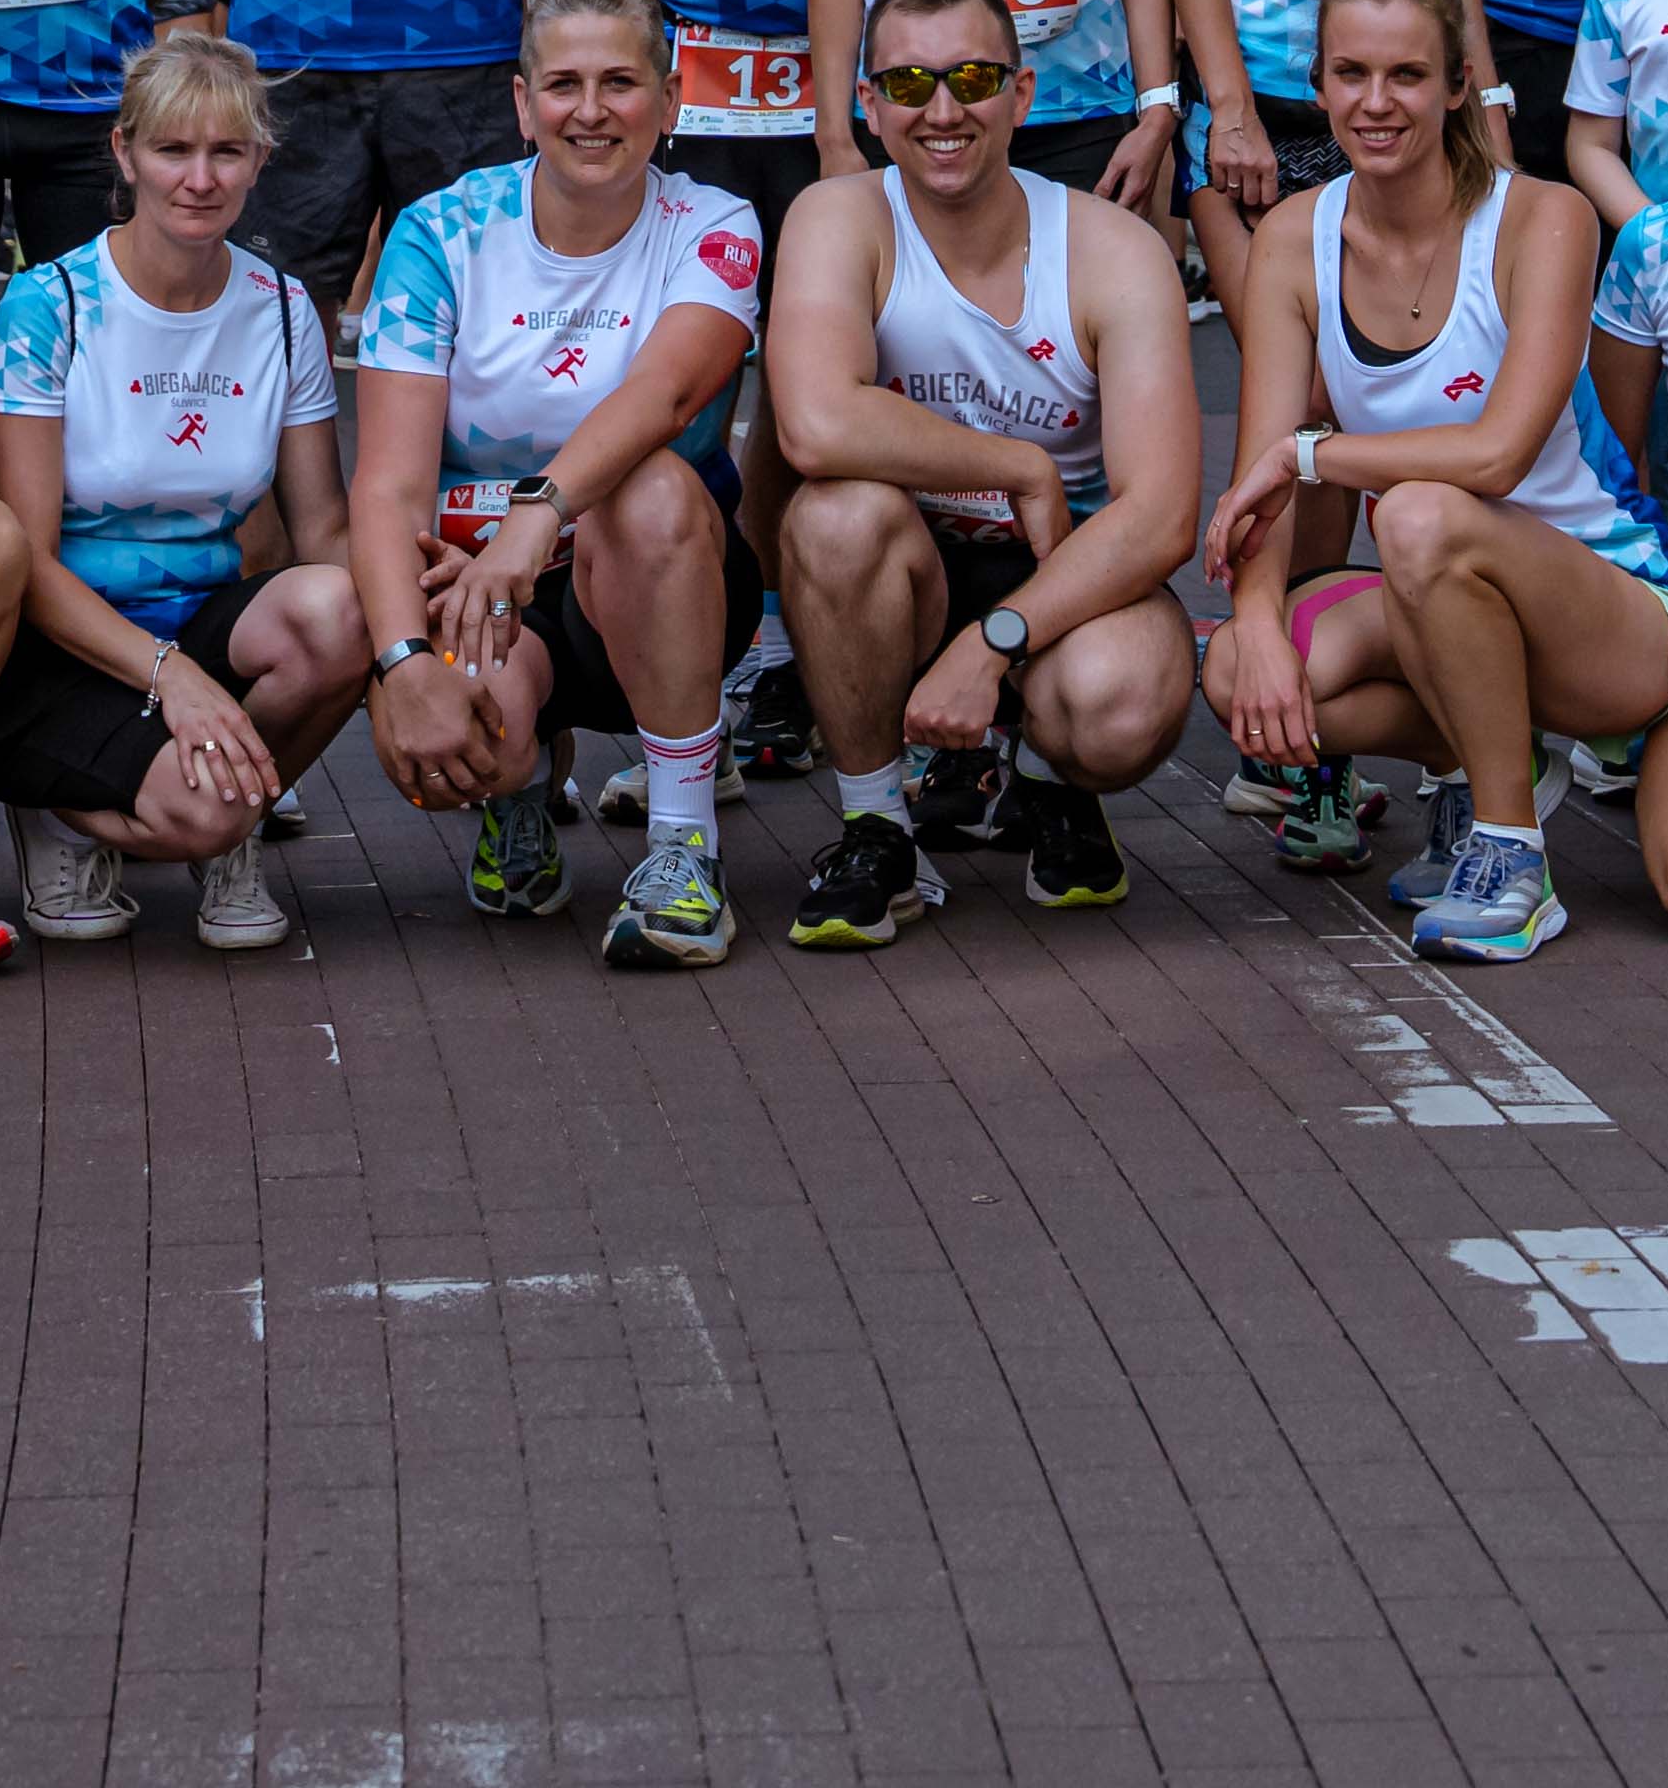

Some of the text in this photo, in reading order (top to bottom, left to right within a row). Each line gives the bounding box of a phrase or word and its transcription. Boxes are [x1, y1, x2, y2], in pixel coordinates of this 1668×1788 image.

[728, 54, 801, 107] 13
[723, 244, 752, 268] RUN
[908, 372, 1063, 431] BIEGAJĄCE
[481, 484, 492, 496] 1.
[479, 502, 507, 512] Grand
